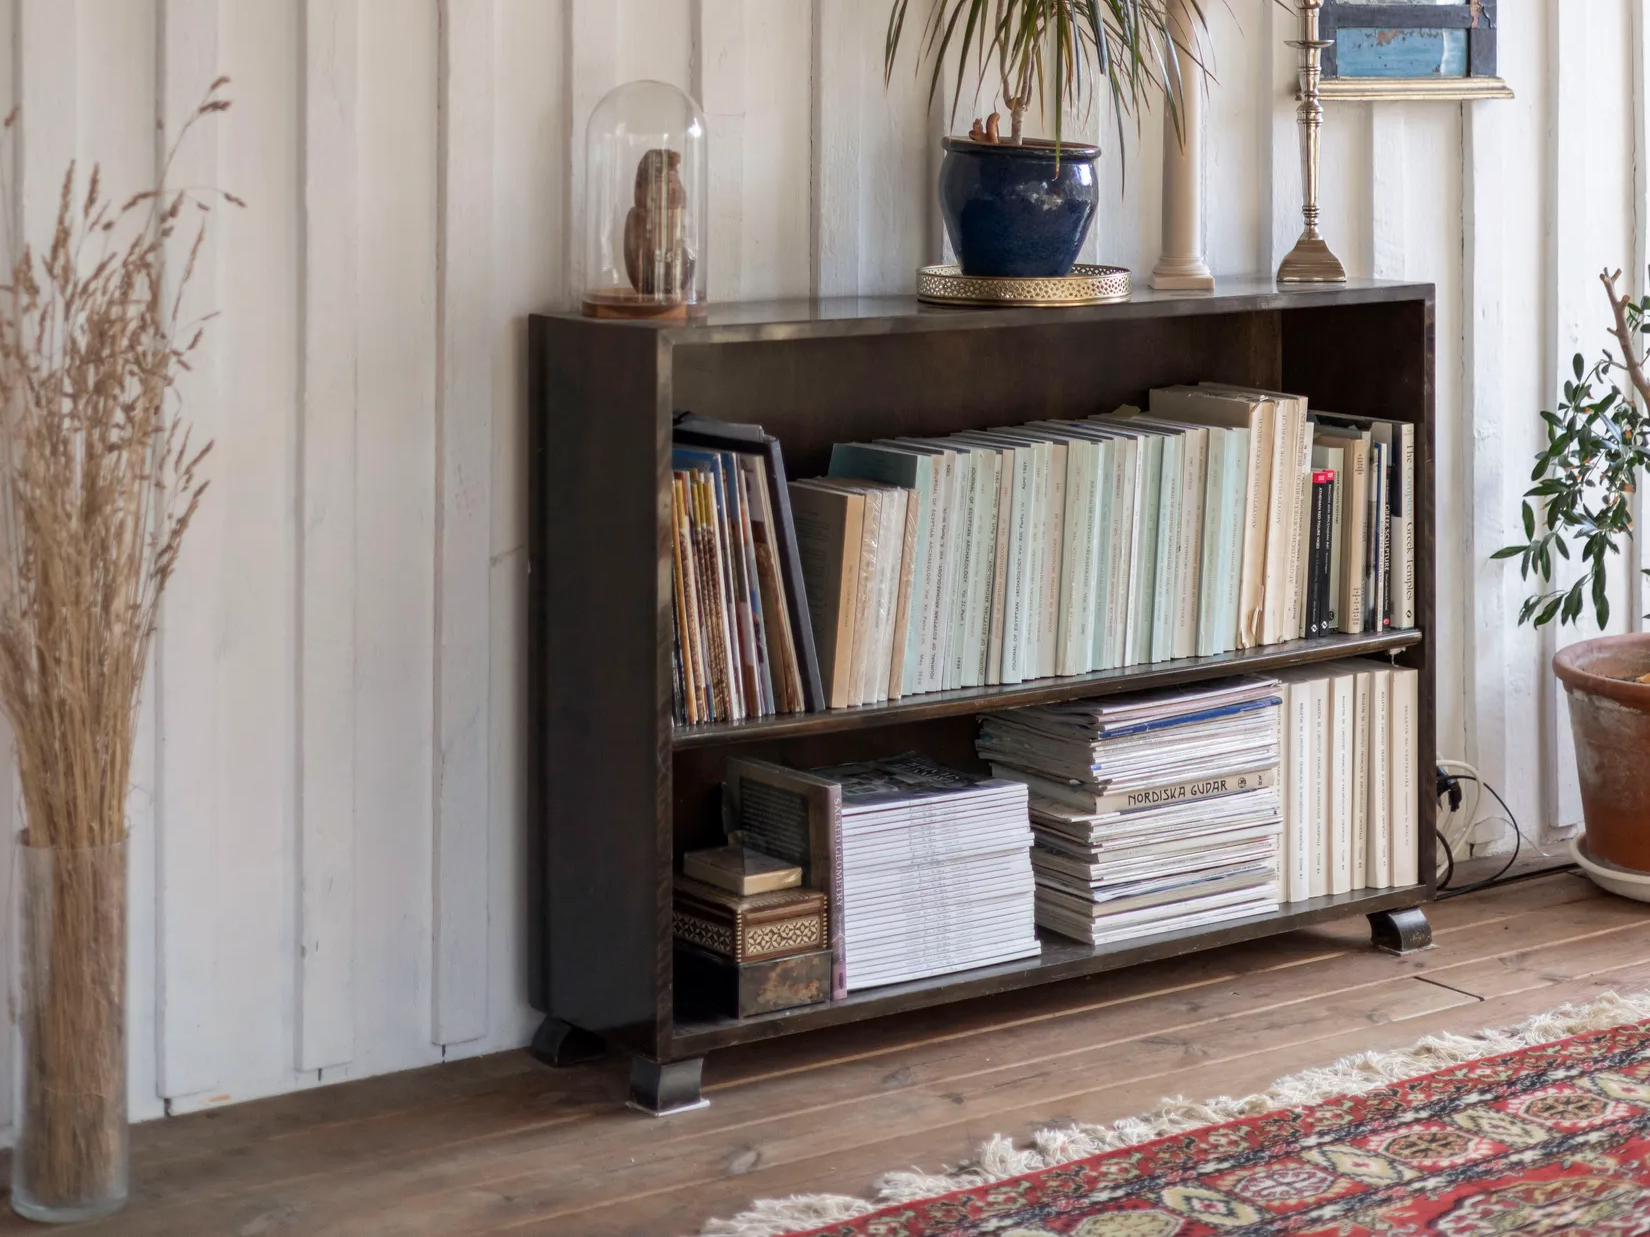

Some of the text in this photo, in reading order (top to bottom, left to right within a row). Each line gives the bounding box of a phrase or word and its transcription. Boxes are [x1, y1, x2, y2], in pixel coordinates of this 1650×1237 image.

[1404, 444, 1414, 601] The Complete Greek Temples
[1128, 780, 1228, 806] NORDISKA GUDAR
[835, 845, 843, 907] GEOMETRY
